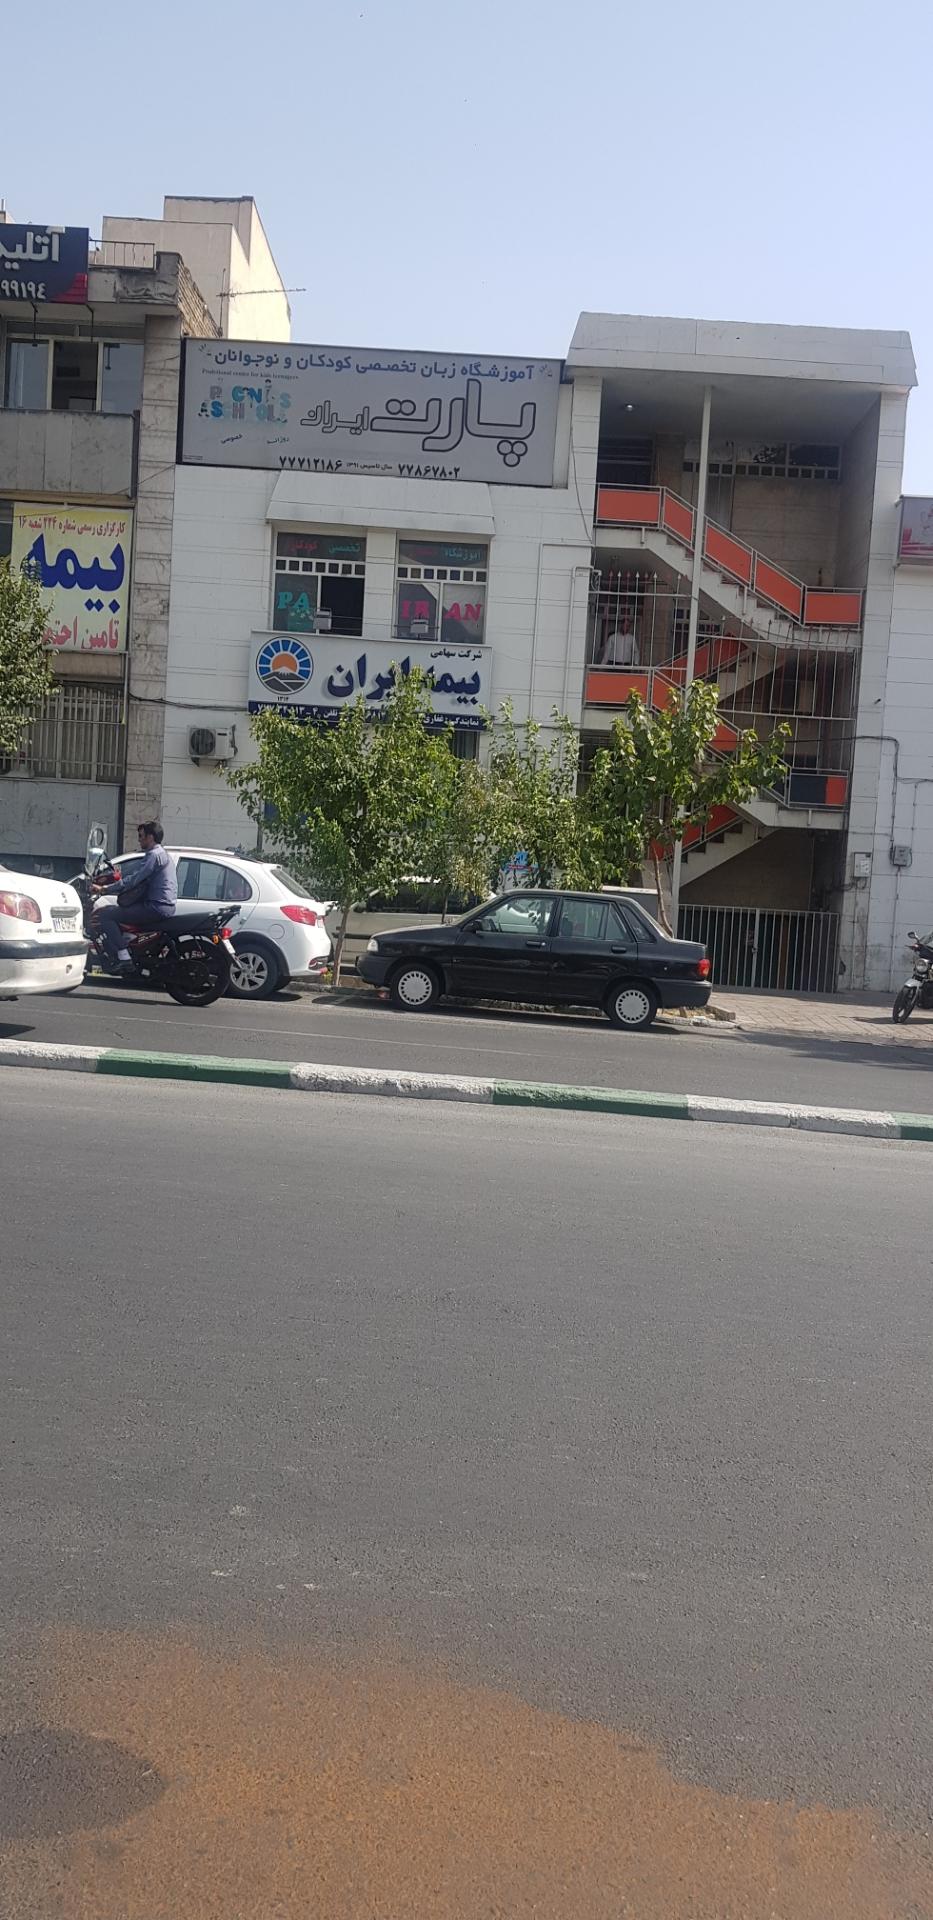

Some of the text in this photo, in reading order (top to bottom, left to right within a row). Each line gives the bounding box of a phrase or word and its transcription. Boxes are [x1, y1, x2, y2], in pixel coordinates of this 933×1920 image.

[0, 226, 65, 270] آتلی
[214, 349, 535, 382] آموزشگاه زبان تخصصی کودکان و نوجوانان
[300, 378, 537, 468] پارت ایران
[279, 455, 343, 472] ۷۷۷۱۲۱۸۶
[398, 463, 460, 478] ۷۷۸۶۷۸۰۲
[97, 521, 126, 538] کارگزاری
[20, 533, 125, 614] بیمه
[81, 617, 120, 650] تامین
[430, 648, 482, 661] شرکت سهامی
